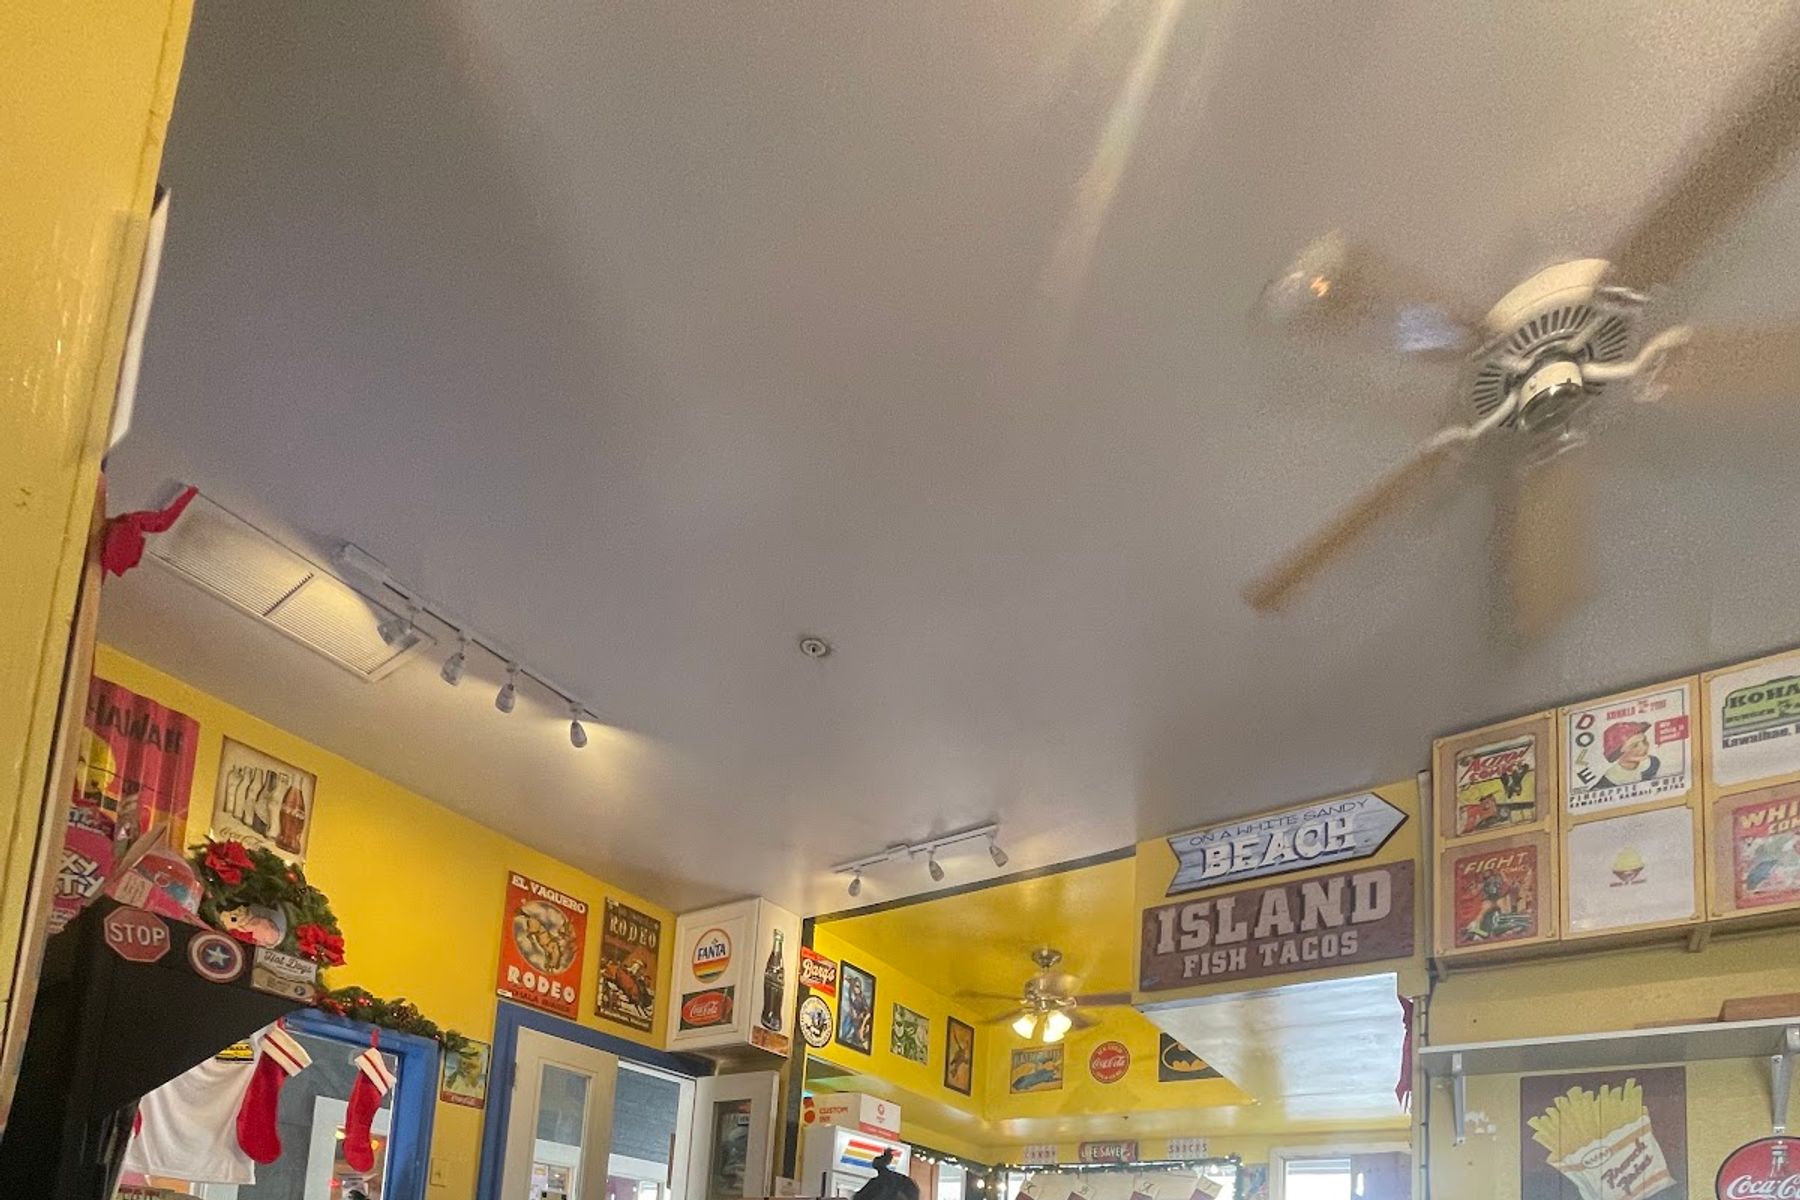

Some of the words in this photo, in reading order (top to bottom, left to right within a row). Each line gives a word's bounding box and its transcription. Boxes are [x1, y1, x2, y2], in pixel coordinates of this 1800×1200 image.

[1189, 833, 1215, 847] ON
[1220, 829, 1232, 840] A
[1237, 816, 1299, 836] WHITE
[1303, 798, 1369, 821] SANDY
[1202, 816, 1358, 878] BEACH
[1464, 852, 1528, 874] FIGHT
[511, 874, 529, 891] EL
[530, 882, 586, 914] VAQUERO
[1156, 870, 1392, 955] ISLAND
[110, 921, 166, 946] STOP
[609, 914, 657, 949] RODEO
[697, 943, 726, 961] FANTA
[1183, 948, 1247, 978] FISH
[1259, 930, 1359, 967] TACOS
[507, 965, 576, 1003] RODEO
